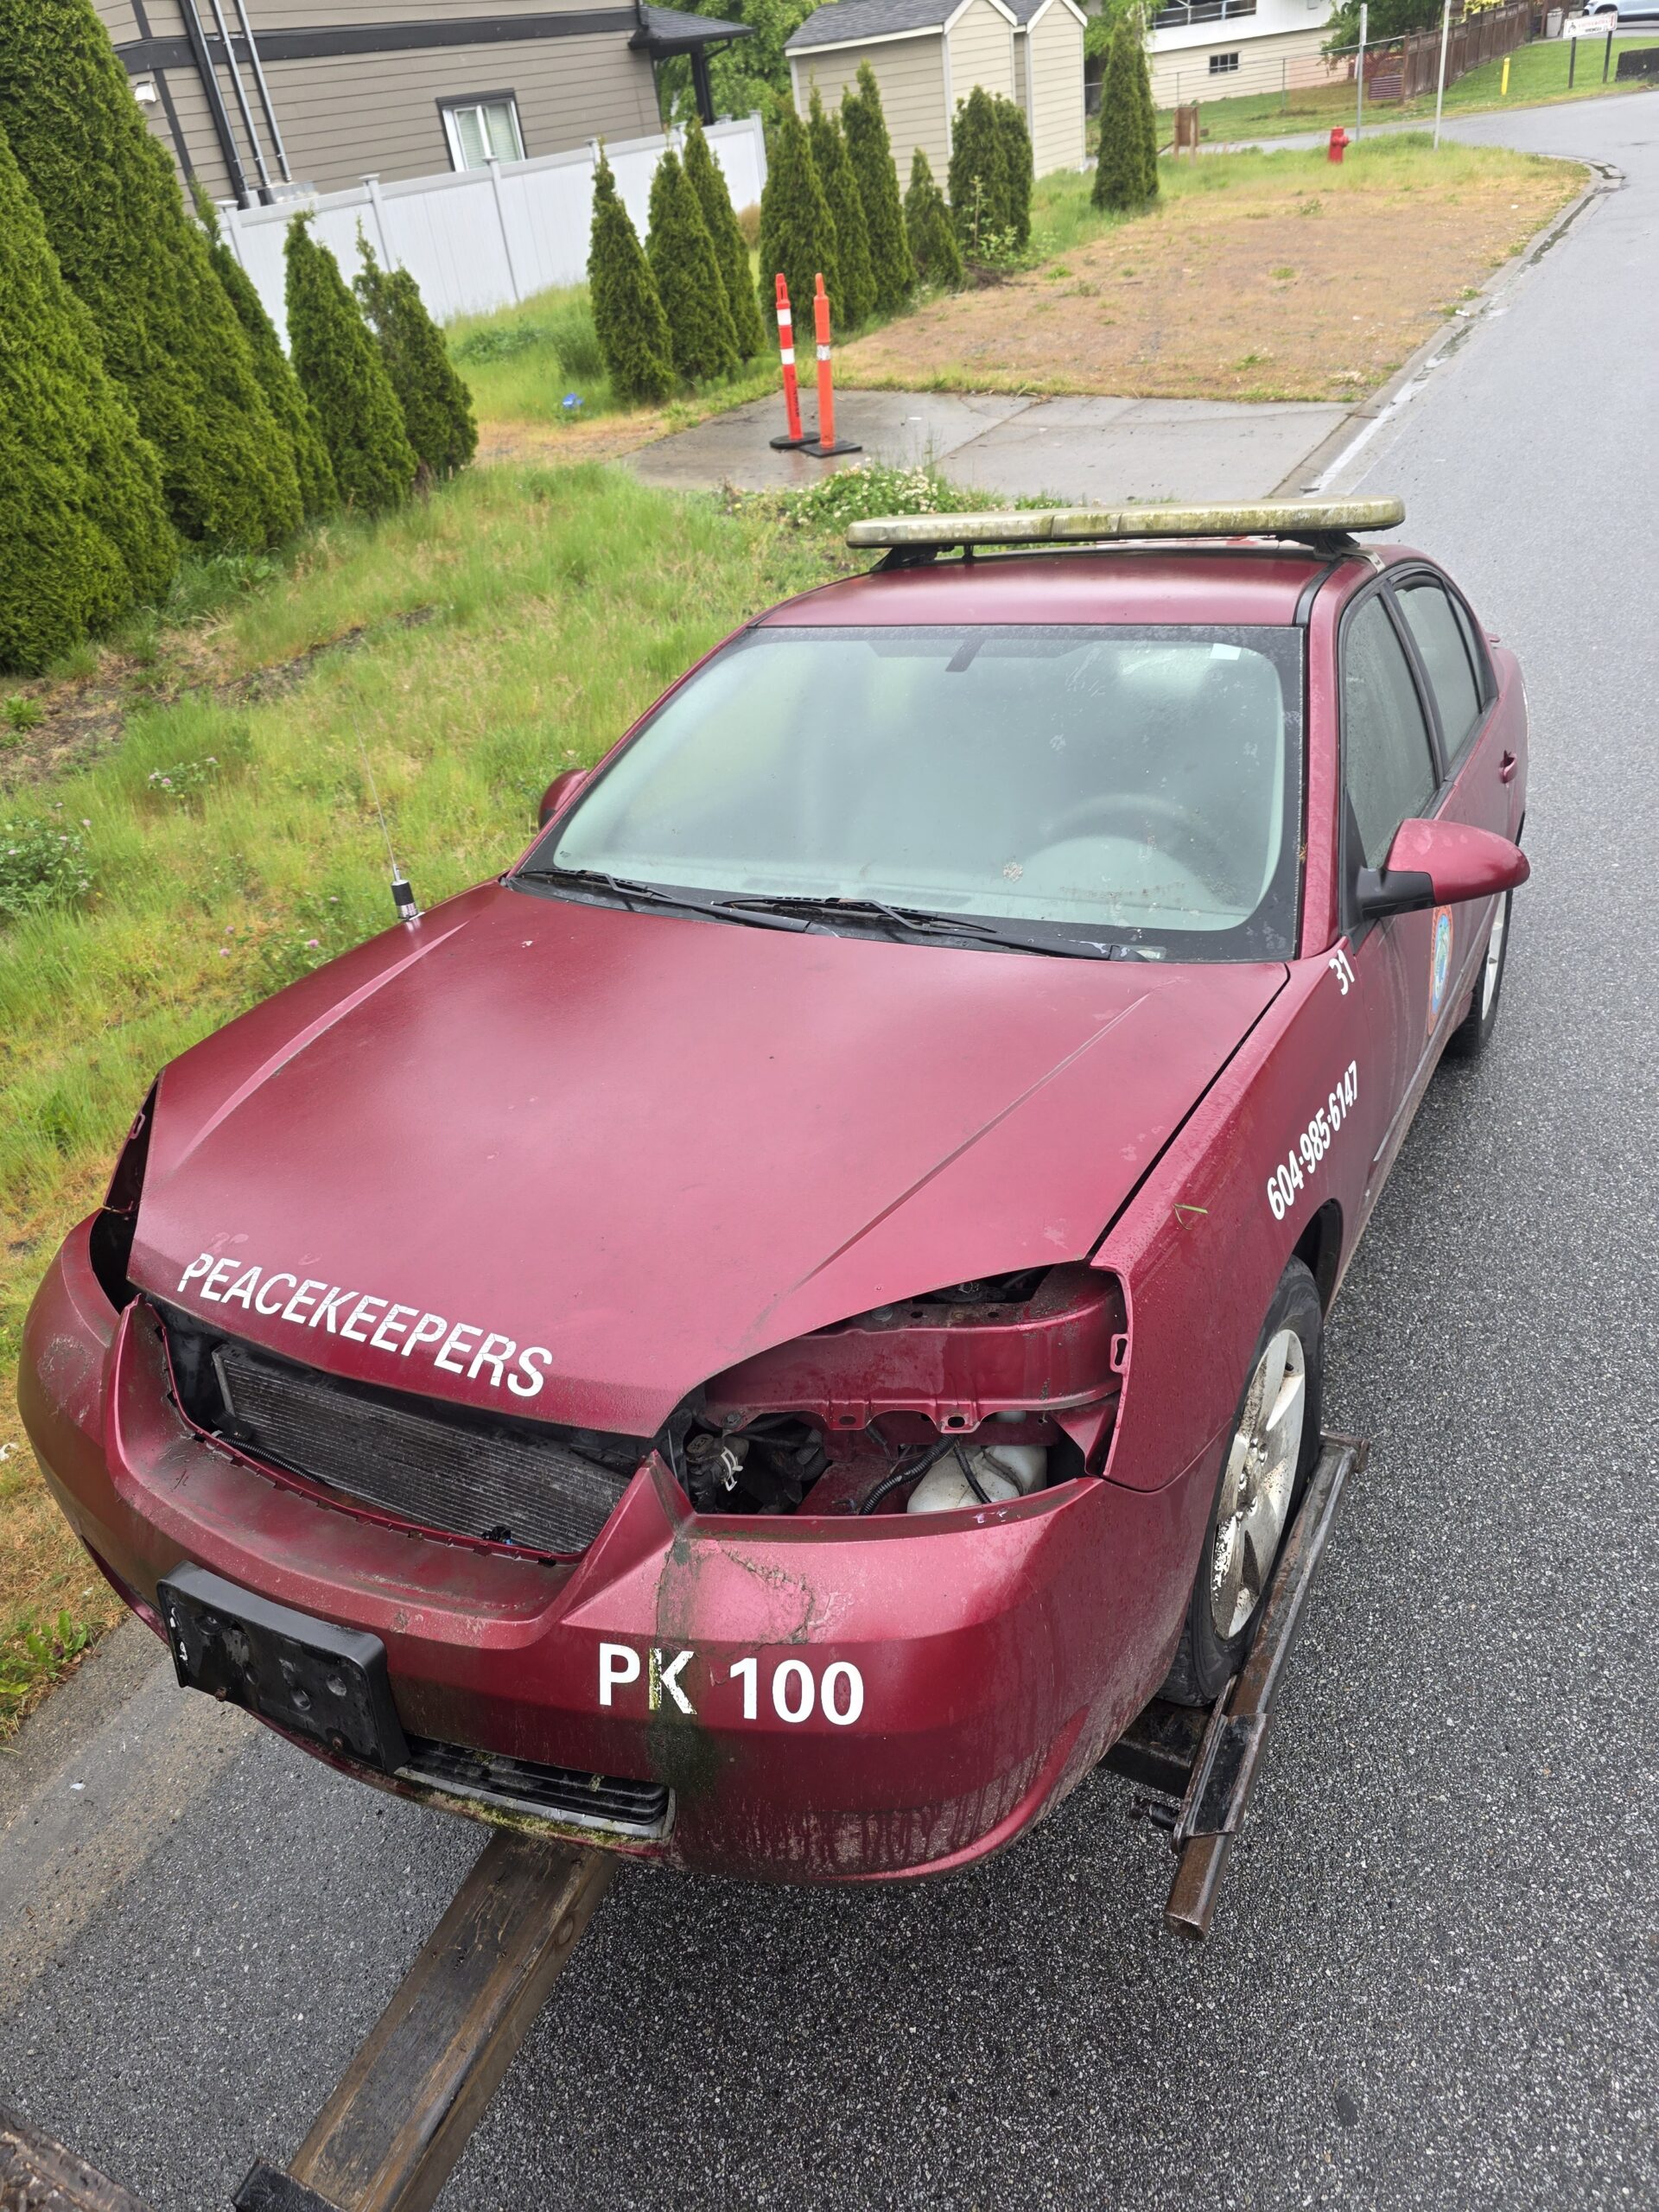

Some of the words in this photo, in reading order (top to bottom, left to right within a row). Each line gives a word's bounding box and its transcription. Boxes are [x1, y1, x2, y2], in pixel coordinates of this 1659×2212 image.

[1328, 949, 1356, 996] 31
[1266, 1059, 1360, 1222] 604-985-6147
[176, 1252, 554, 1399] PEACEKEEPERS
[598, 1642, 697, 1715] PK
[729, 1656, 865, 1726] 100
